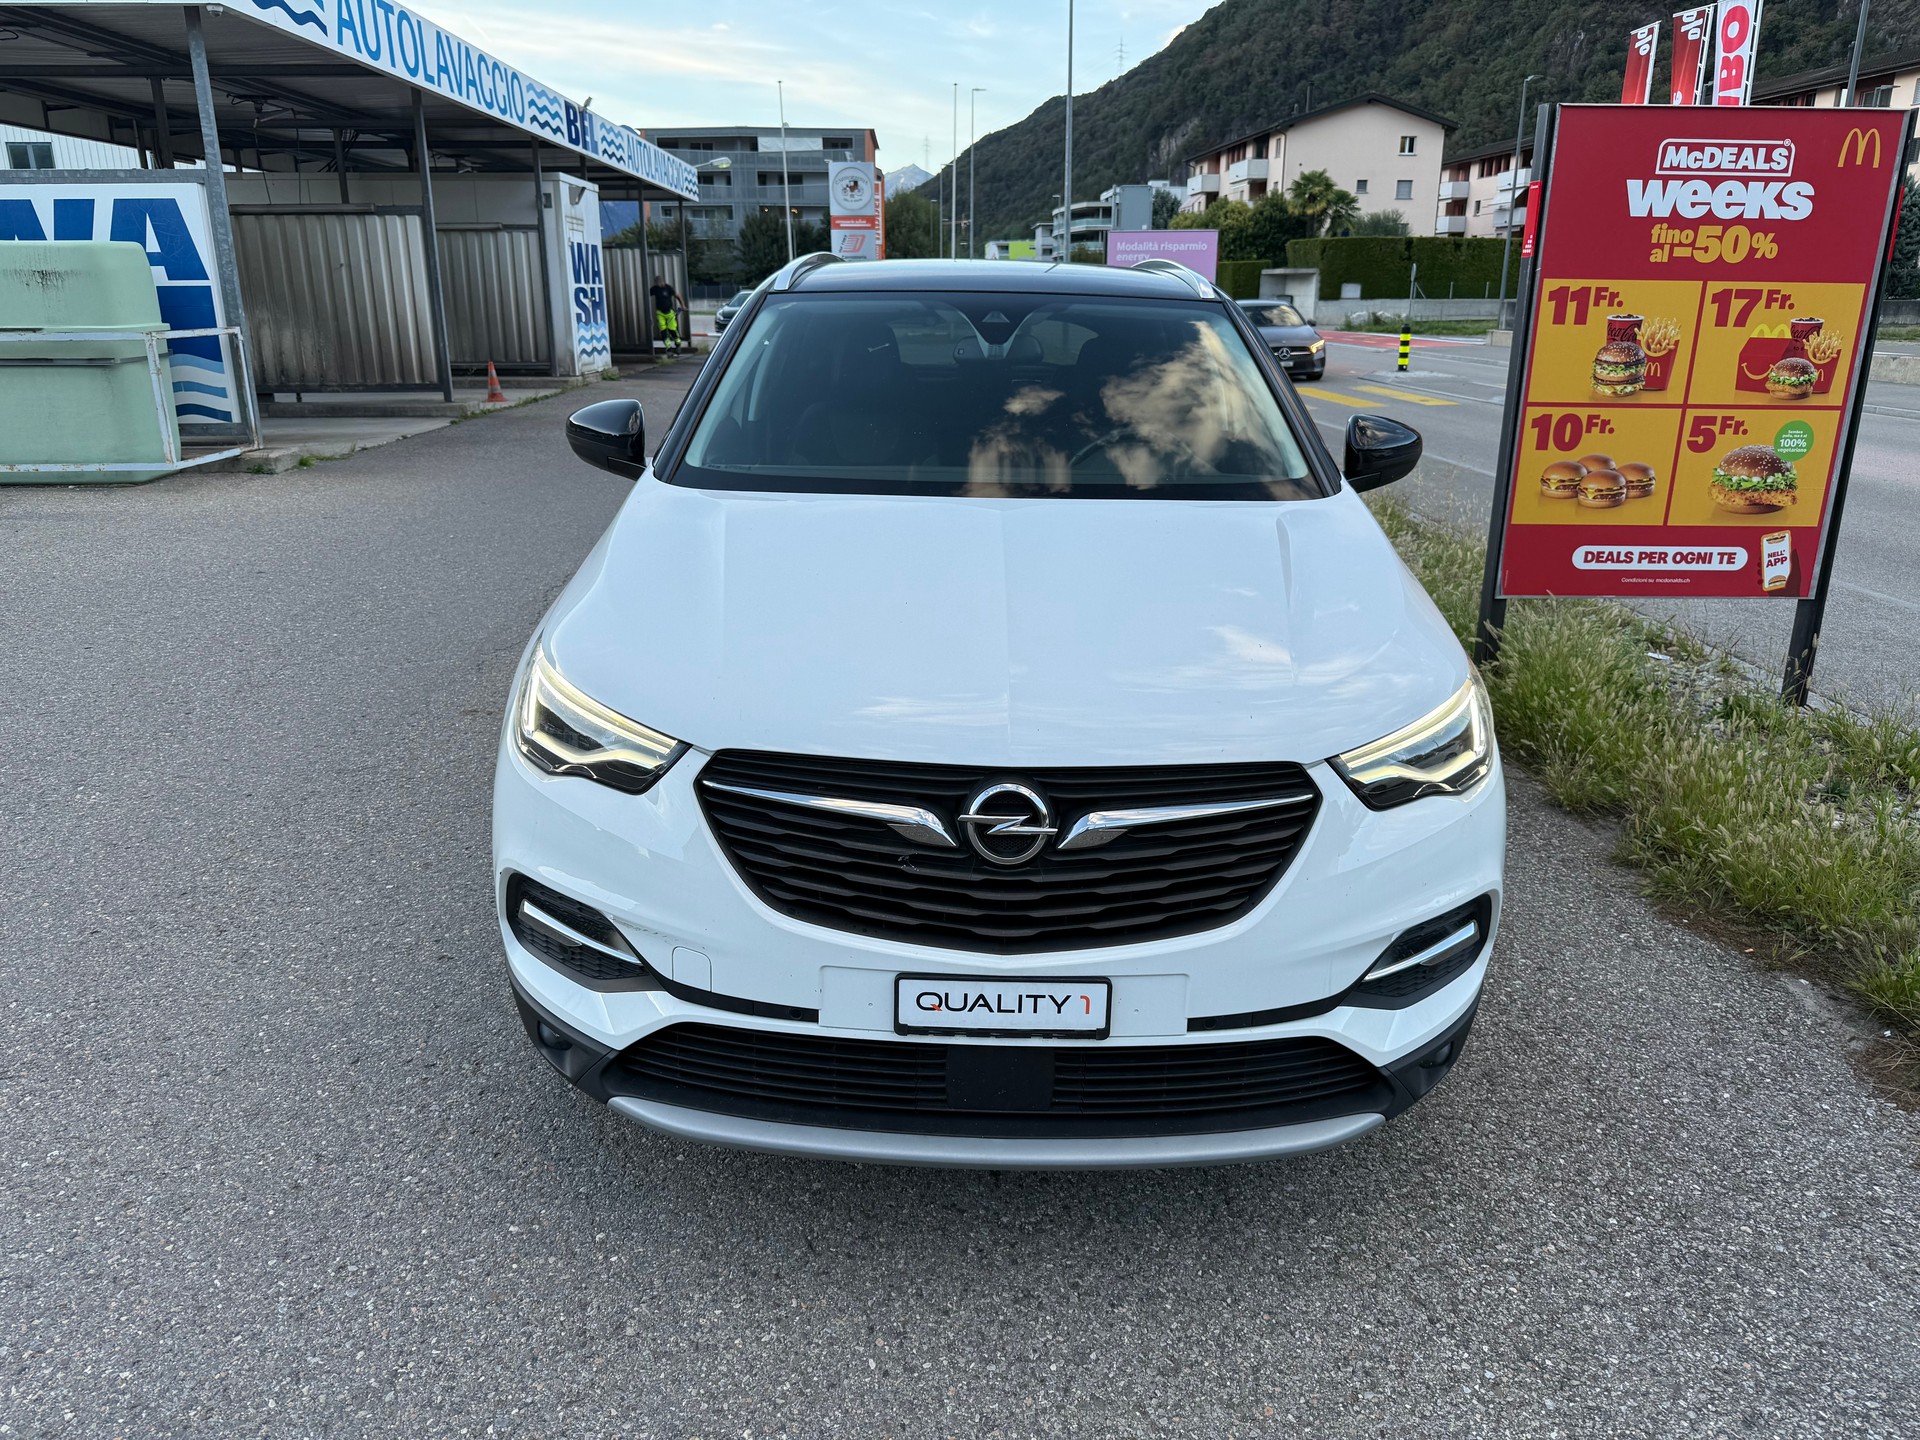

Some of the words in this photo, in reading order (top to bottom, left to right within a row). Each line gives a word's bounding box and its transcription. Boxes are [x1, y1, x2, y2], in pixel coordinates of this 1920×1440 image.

[564, 99, 599, 156] BEL
[1650, 223, 1695, 244] fino
[1116, 241, 1158, 251] Modalità
[1160, 241, 1208, 252] risparmio
[1649, 244, 1669, 263] al
[1547, 286, 1592, 325] 11
[1593, 287, 1624, 307] Fr.
[1711, 288, 1764, 328] 17
[1764, 289, 1795, 310] Fr.
[1531, 413, 1583, 452] 10
[1585, 414, 1615, 435] Fr.
[1686, 416, 1717, 453] 5
[1719, 416, 1749, 436] Fr.
[1780, 438, 1807, 447] 100%
[1583, 551, 1634, 564] DEALS
[1637, 551, 1668, 564] PER
[1671, 551, 1714, 564] OGNI
[1717, 552, 1737, 564] TE
[1766, 556, 1788, 568] APP
[915, 991, 1072, 1014] QUALITY
[1080, 995, 1091, 1015] 1
